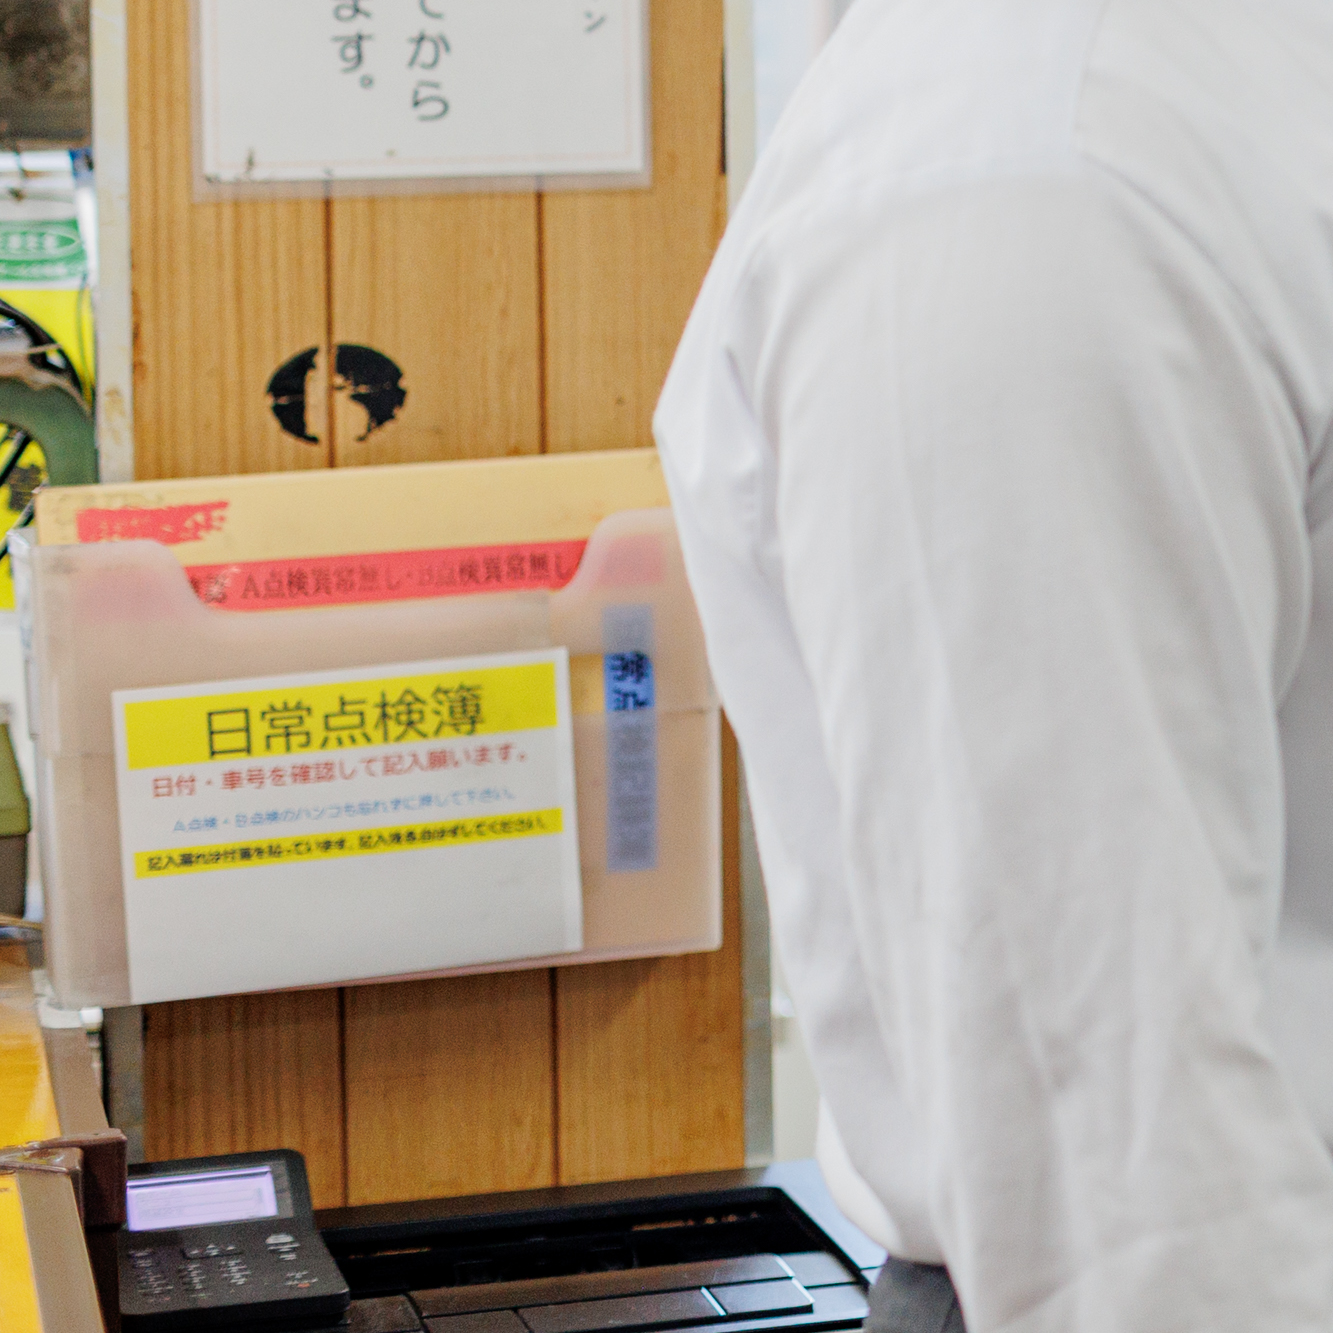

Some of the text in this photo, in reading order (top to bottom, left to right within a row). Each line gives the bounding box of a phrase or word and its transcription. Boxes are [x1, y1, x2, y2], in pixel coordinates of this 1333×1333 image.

[207, 681, 486, 759] 日常点検簿
